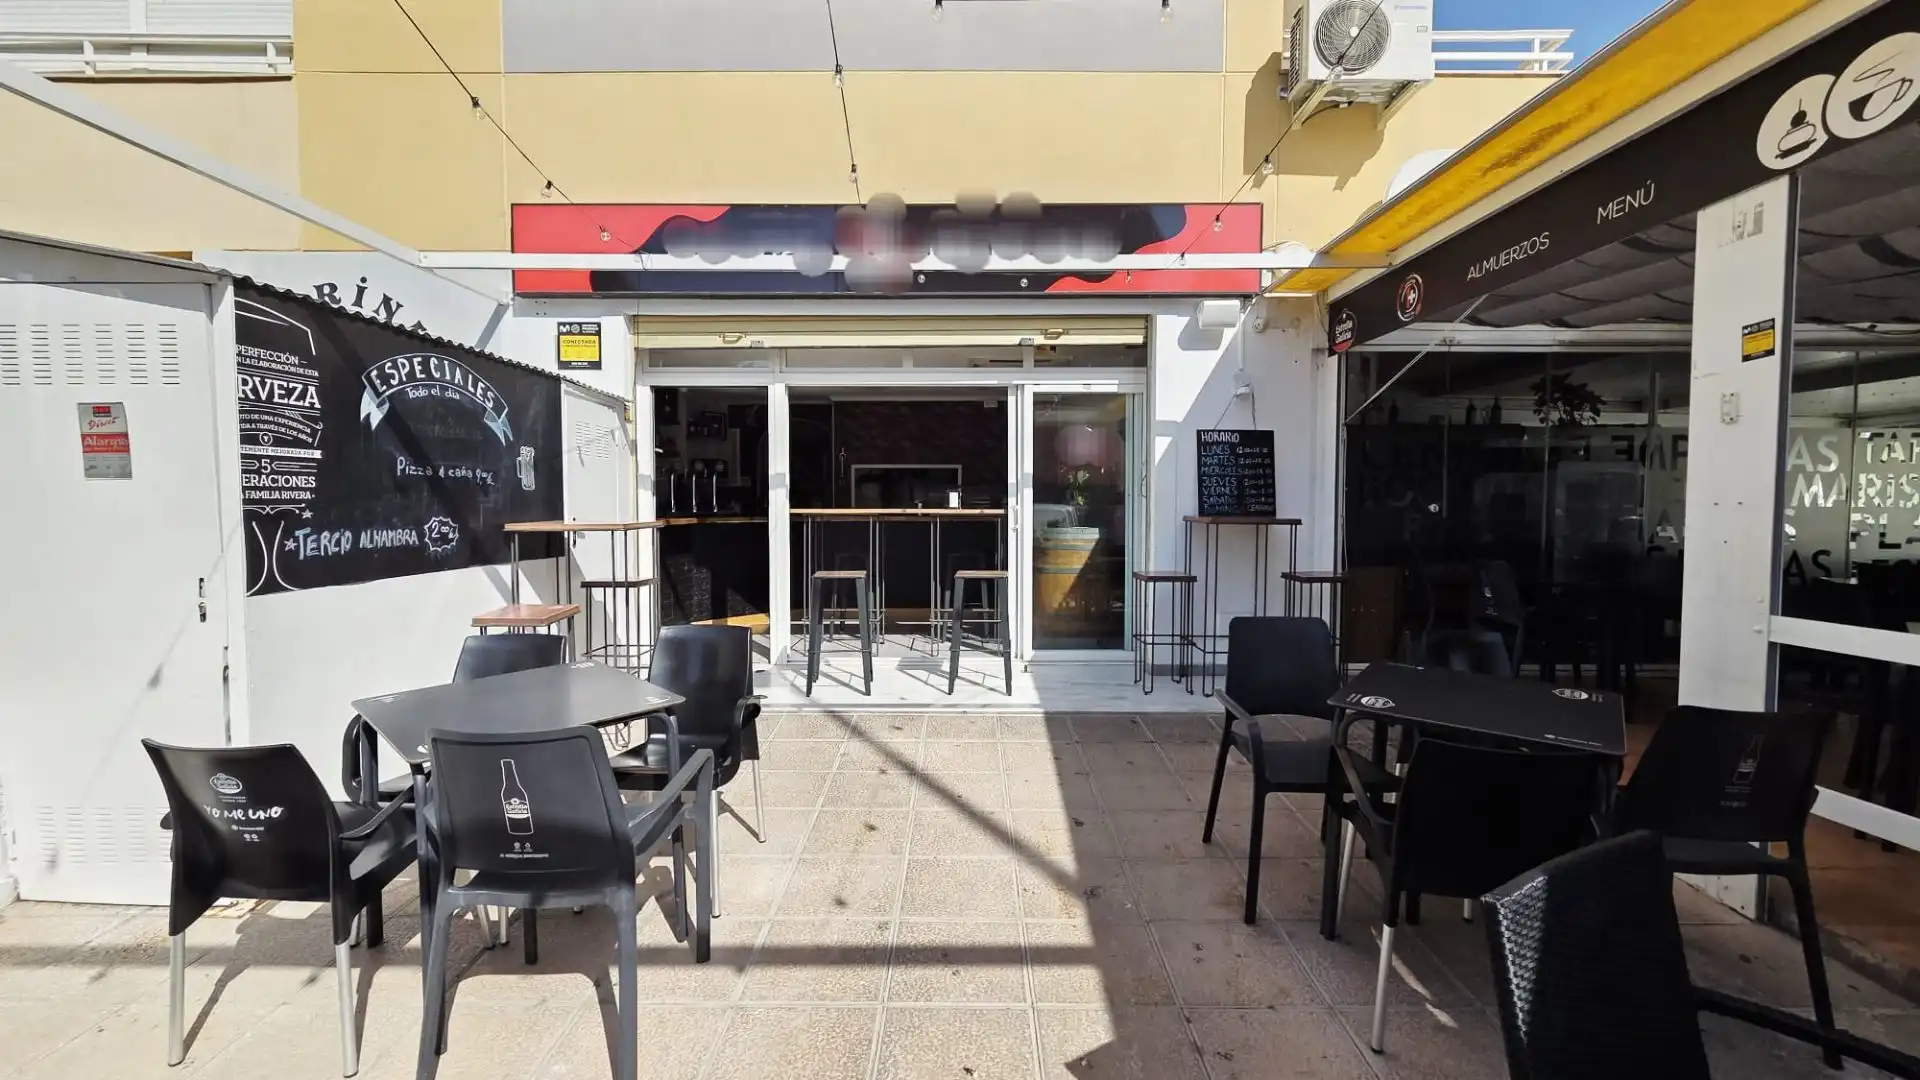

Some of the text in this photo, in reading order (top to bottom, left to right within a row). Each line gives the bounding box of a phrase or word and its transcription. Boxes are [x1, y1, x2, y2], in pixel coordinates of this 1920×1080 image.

[1597, 180, 1656, 225] MENÚ
[1466, 231, 1551, 282] ALMUERZOS
[236, 344, 299, 366] PERFECCIÓN
[252, 358, 297, 374] ELABORACIÓN
[370, 356, 495, 408] ESPECIALES
[237, 373, 321, 409] RVEZA
[405, 386, 428, 400] Todo
[431, 385, 441, 397] el
[260, 414, 274, 422] UNA
[286, 428, 298, 437] LOS
[1201, 431, 1240, 443] HORARIO
[1201, 445, 1231, 455] LUNES
[261, 458, 271, 473] 5
[397, 456, 433, 477] Pizza
[448, 465, 473, 478] caña
[1201, 455, 1236, 466] MARTES
[242, 474, 316, 488] ERACIONES
[1202, 476, 1237, 487] JUEVES
[245, 489, 281, 500] FAMILIA
[282, 490, 312, 500] RIVERA
[360, 528, 420, 549] ALHAMBRA
